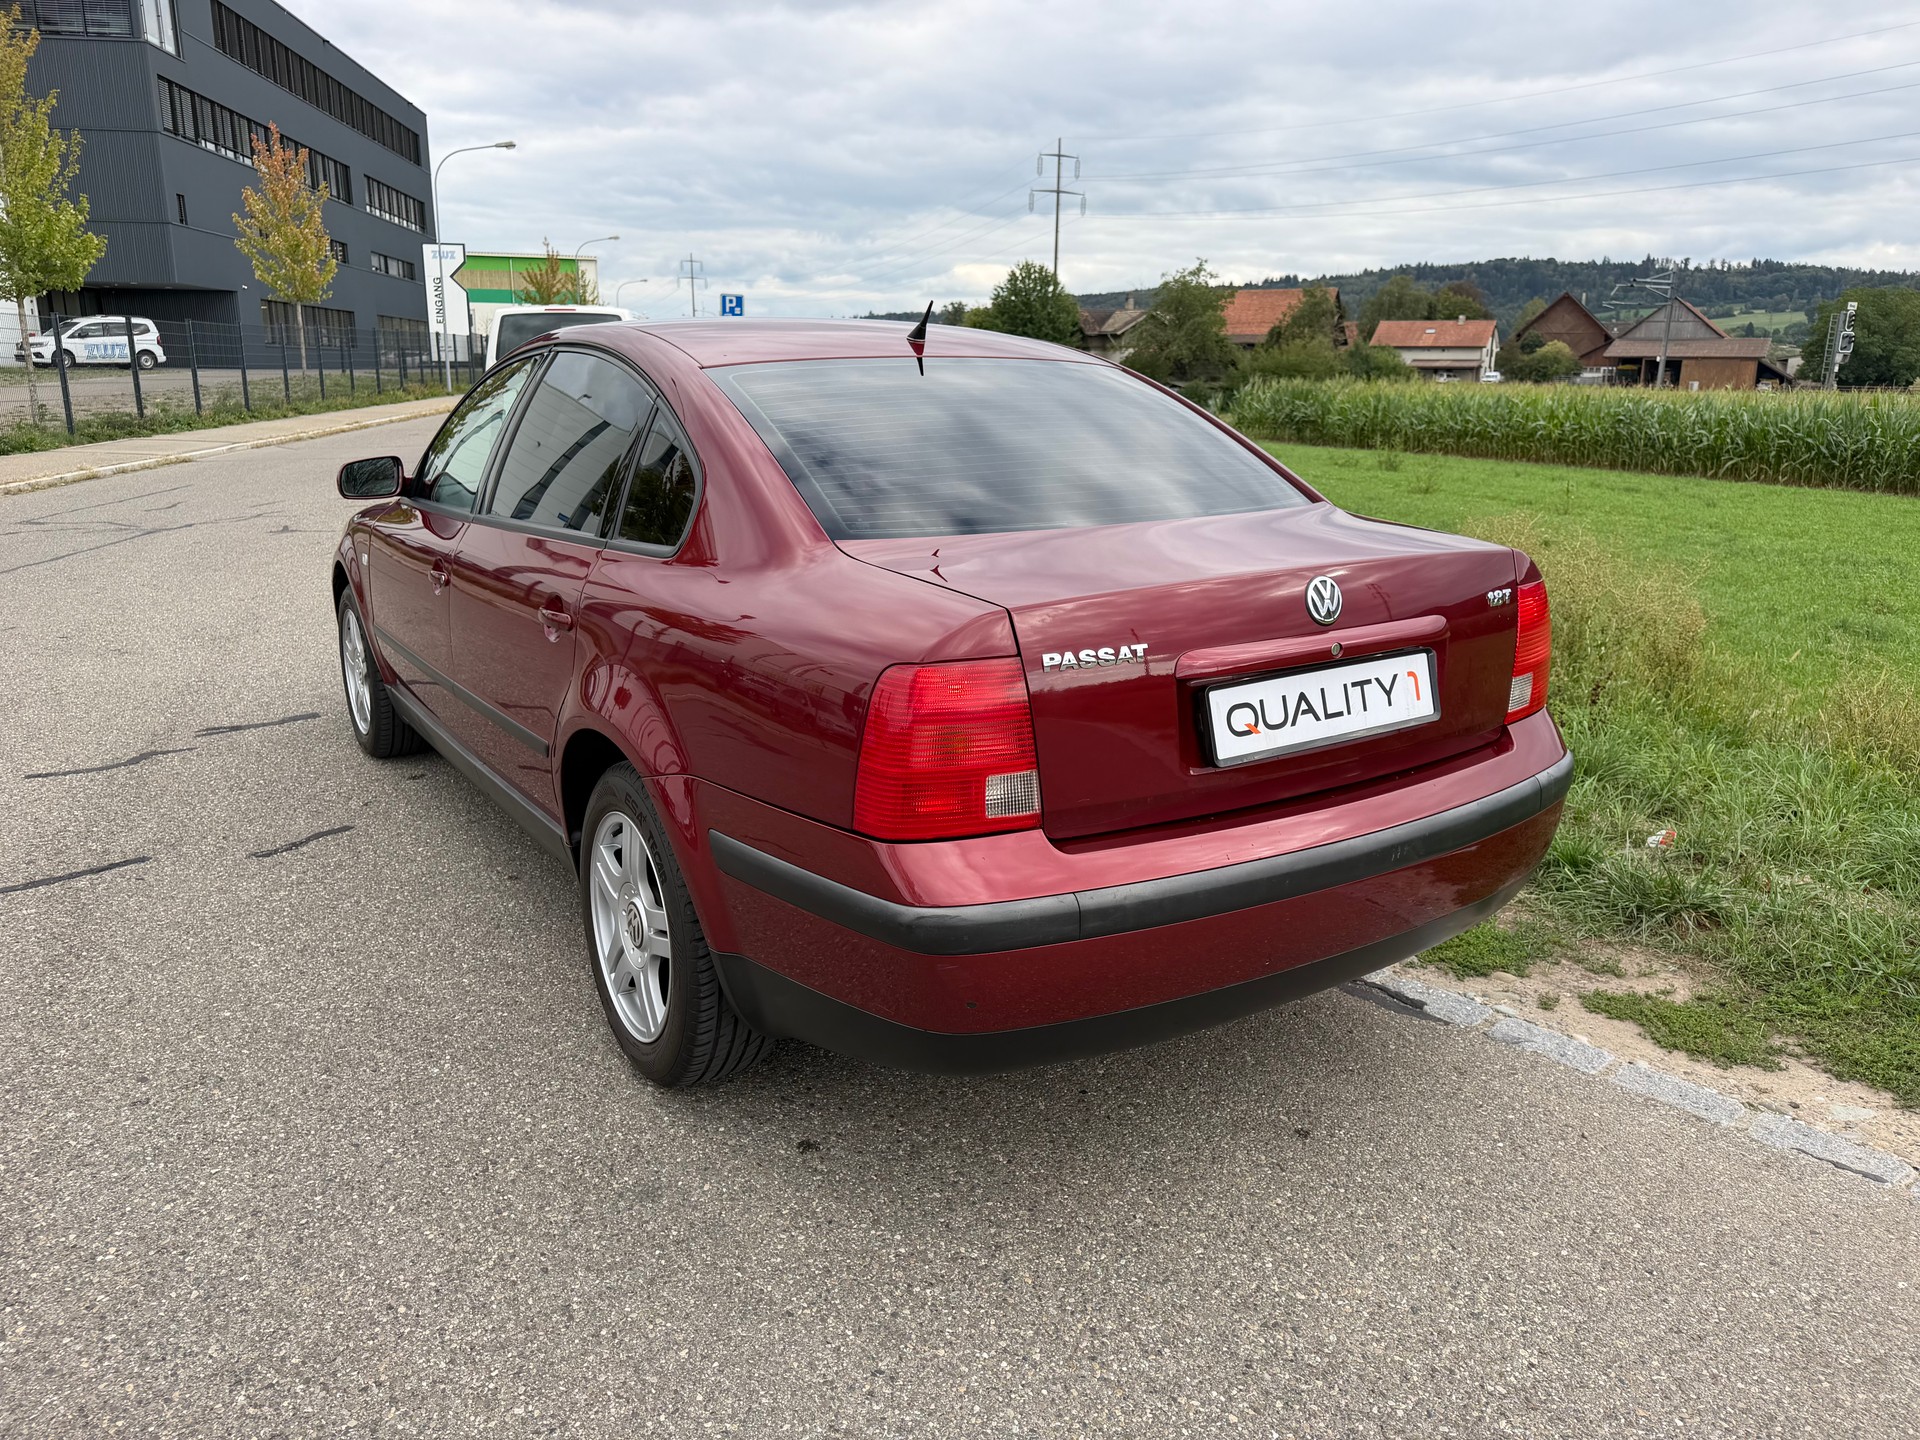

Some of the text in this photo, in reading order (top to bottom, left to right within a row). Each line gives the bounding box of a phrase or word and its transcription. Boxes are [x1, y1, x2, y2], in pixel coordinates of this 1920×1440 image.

[433, 277, 444, 324] EINGANG
[725, 296, 737, 313] P
[1307, 576, 1342, 622] VW
[1042, 643, 1149, 673] PASSAT
[1226, 671, 1421, 737] QUALITY 1
[647, 829, 668, 886] TECAR
